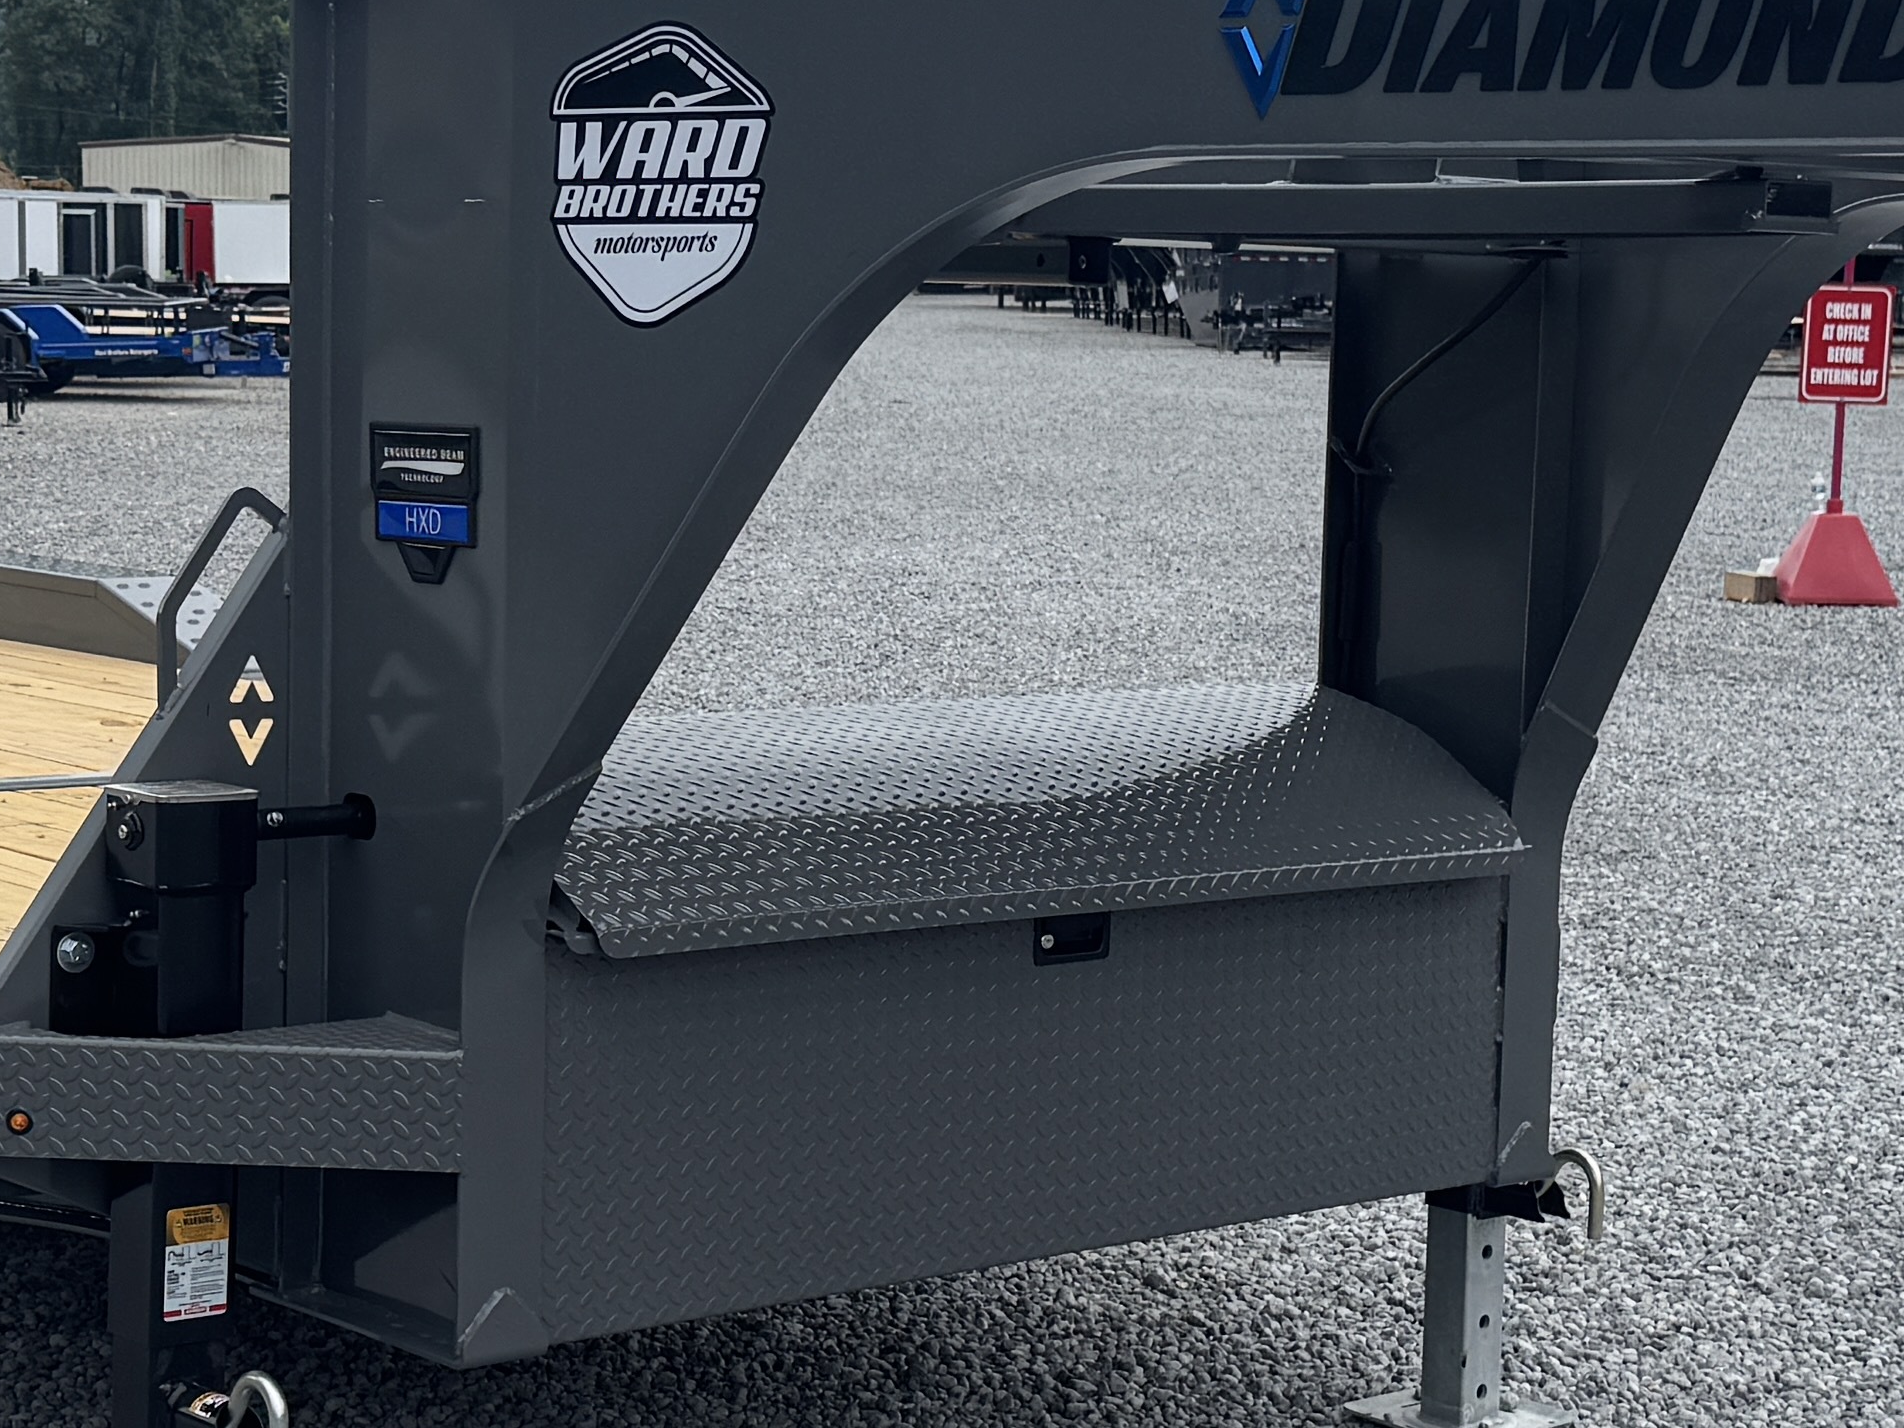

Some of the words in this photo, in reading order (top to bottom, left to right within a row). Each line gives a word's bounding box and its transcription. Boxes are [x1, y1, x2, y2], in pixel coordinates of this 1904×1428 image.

[556, 118, 767, 180] WARD
[554, 184, 761, 218] BROTHERS
[593, 230, 718, 262] motorsports
[1825, 301, 1859, 320] CHECK
[1861, 303, 1872, 320] IN
[1822, 324, 1836, 341] AT
[1836, 324, 1870, 342] OFFICE
[1827, 346, 1865, 364] BEFORE
[1810, 367, 1858, 386] ENTERING
[1860, 368, 1879, 386] LOT
[383, 446, 438, 460] ENGINEERED
[439, 448, 465, 461] BEAM
[405, 507, 442, 535] HXD
